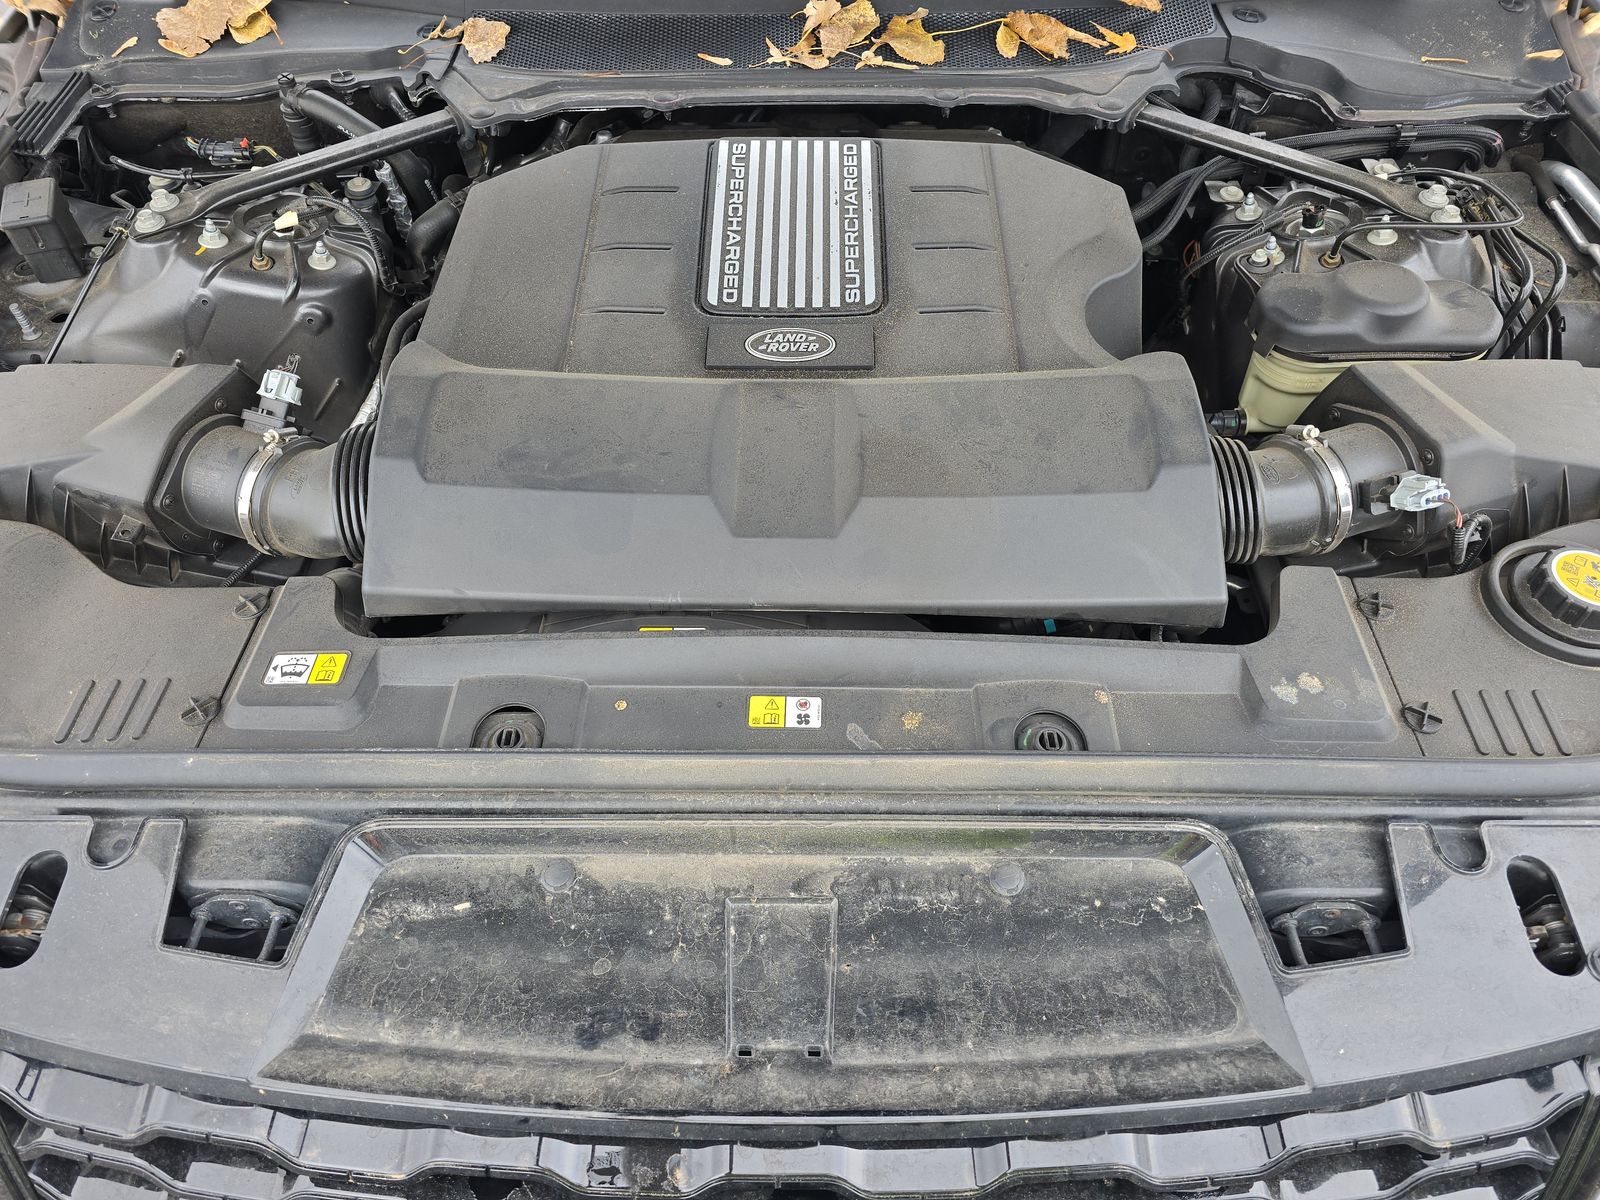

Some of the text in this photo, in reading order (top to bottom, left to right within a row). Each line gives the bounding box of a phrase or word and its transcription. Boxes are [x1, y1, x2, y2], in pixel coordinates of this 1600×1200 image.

[722, 143, 747, 303] SUPERCHARGED
[843, 143, 861, 303] SUPERCHARGED
[764, 333, 807, 343] LAND
[767, 342, 820, 352] ROVER
